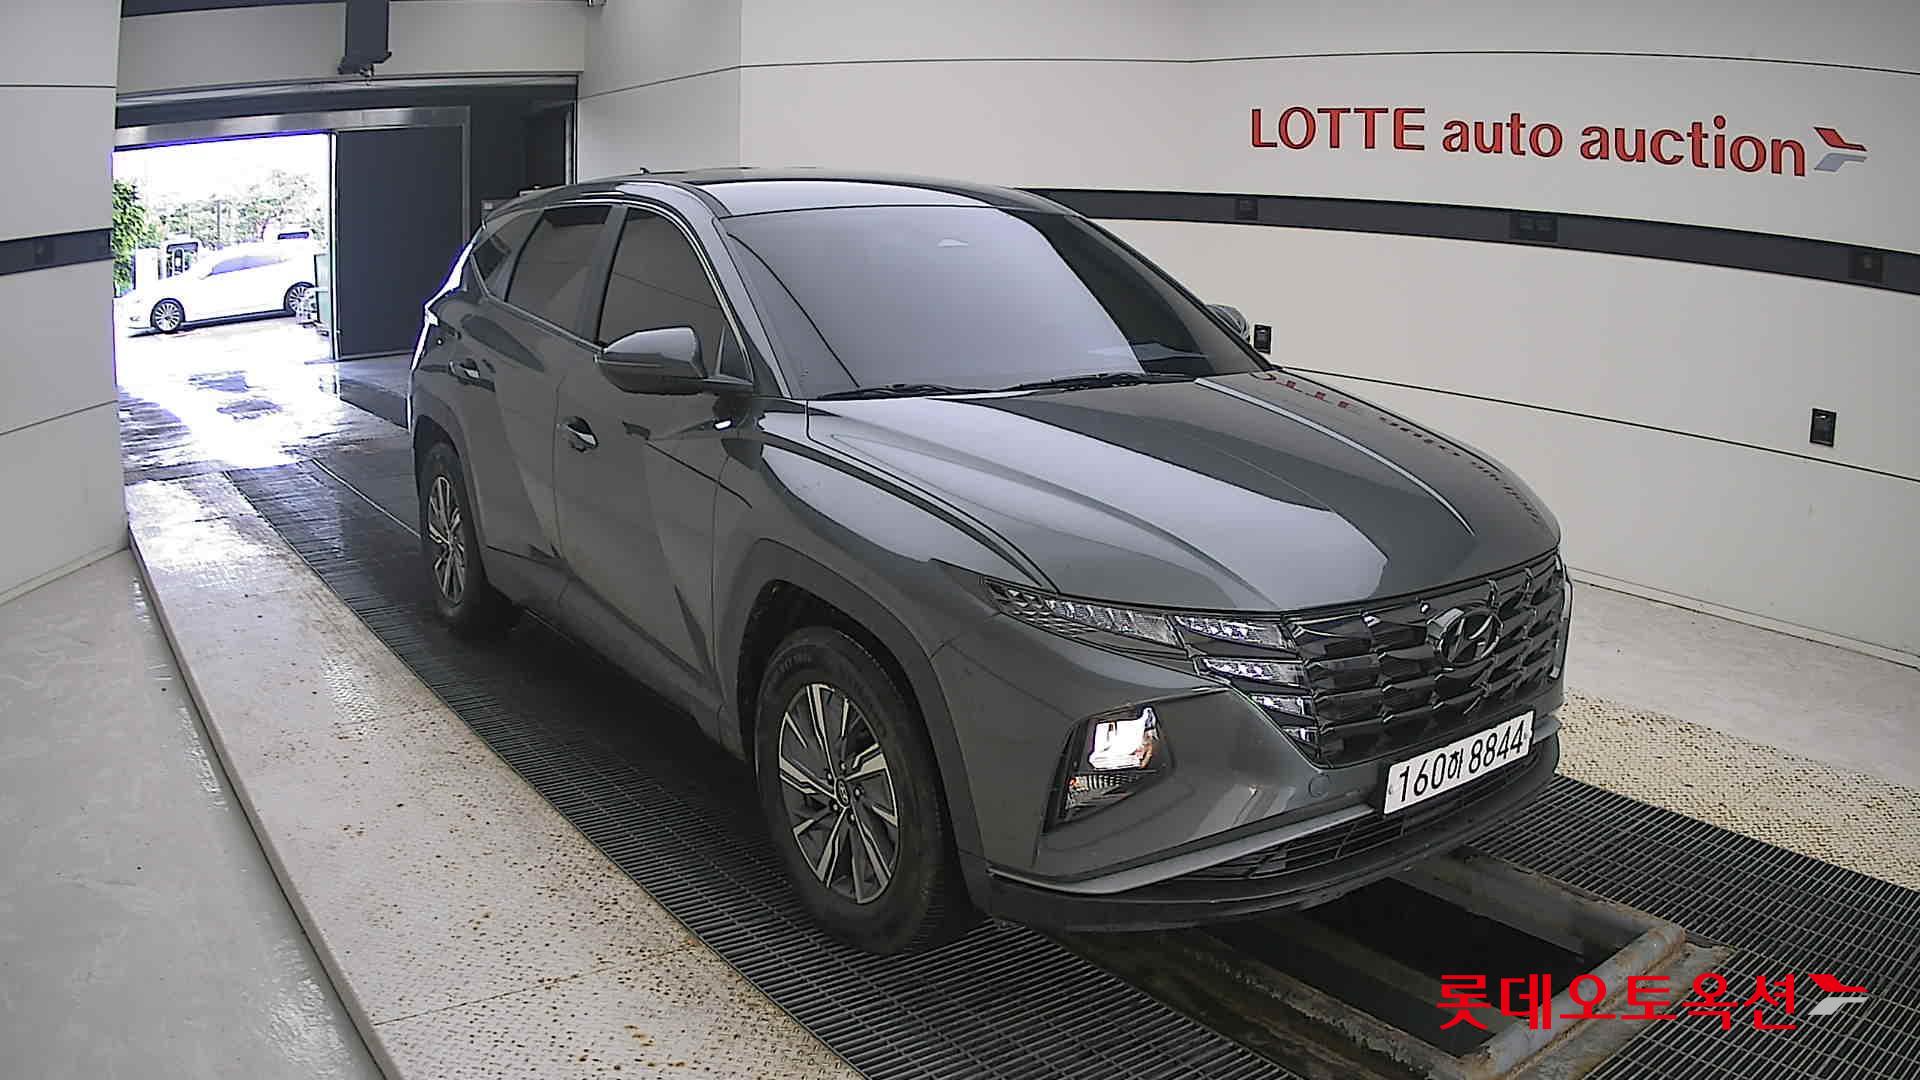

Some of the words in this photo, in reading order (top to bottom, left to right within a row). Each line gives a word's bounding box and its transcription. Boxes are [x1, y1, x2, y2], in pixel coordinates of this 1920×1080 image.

[1251, 107, 1426, 151] LOTTE
[1442, 112, 1563, 158] auto
[1580, 115, 1806, 177] auction
[1399, 747, 1464, 802] 160하
[1468, 719, 1525, 774] 8844
